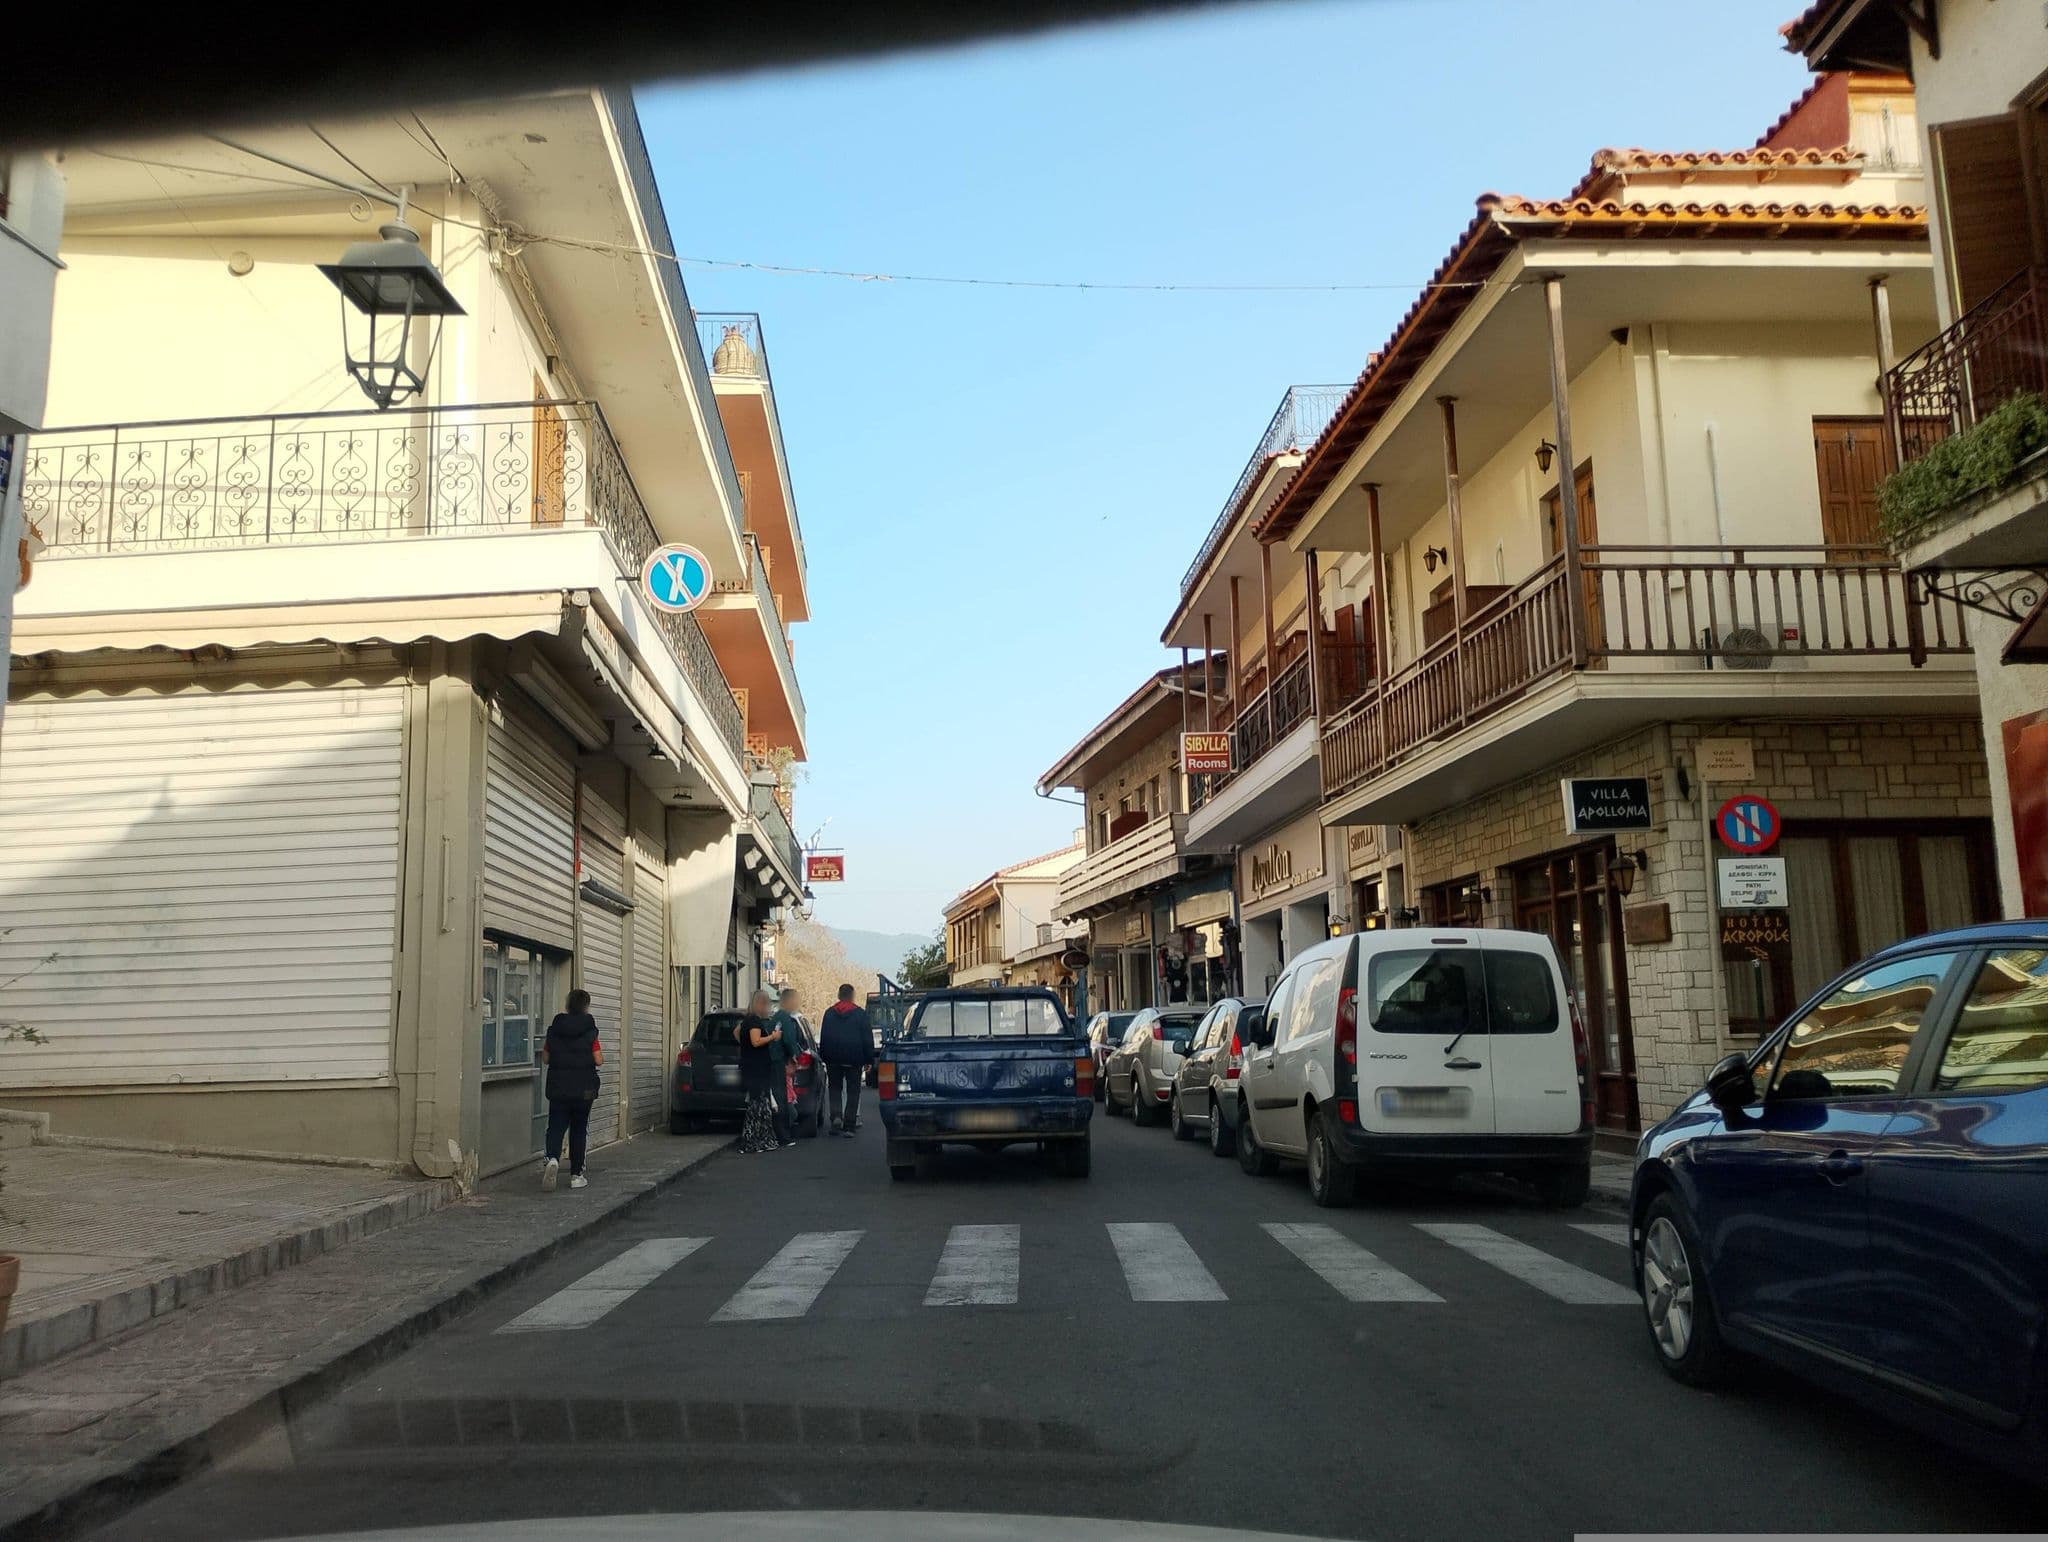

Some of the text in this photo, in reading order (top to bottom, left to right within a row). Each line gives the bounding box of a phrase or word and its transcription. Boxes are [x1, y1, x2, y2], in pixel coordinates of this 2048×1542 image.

[1185, 736, 1228, 751] SIBYLLA
[1188, 758, 1228, 769] Rooms
[1590, 788, 1630, 800] VILLA
[1578, 805, 1648, 820] APOLLONIA
[811, 869, 840, 877] LETO
[1252, 845, 1291, 900] Apollon
[1727, 915, 1782, 928] HOTEL
[1723, 928, 1790, 944] ACROPOLE
